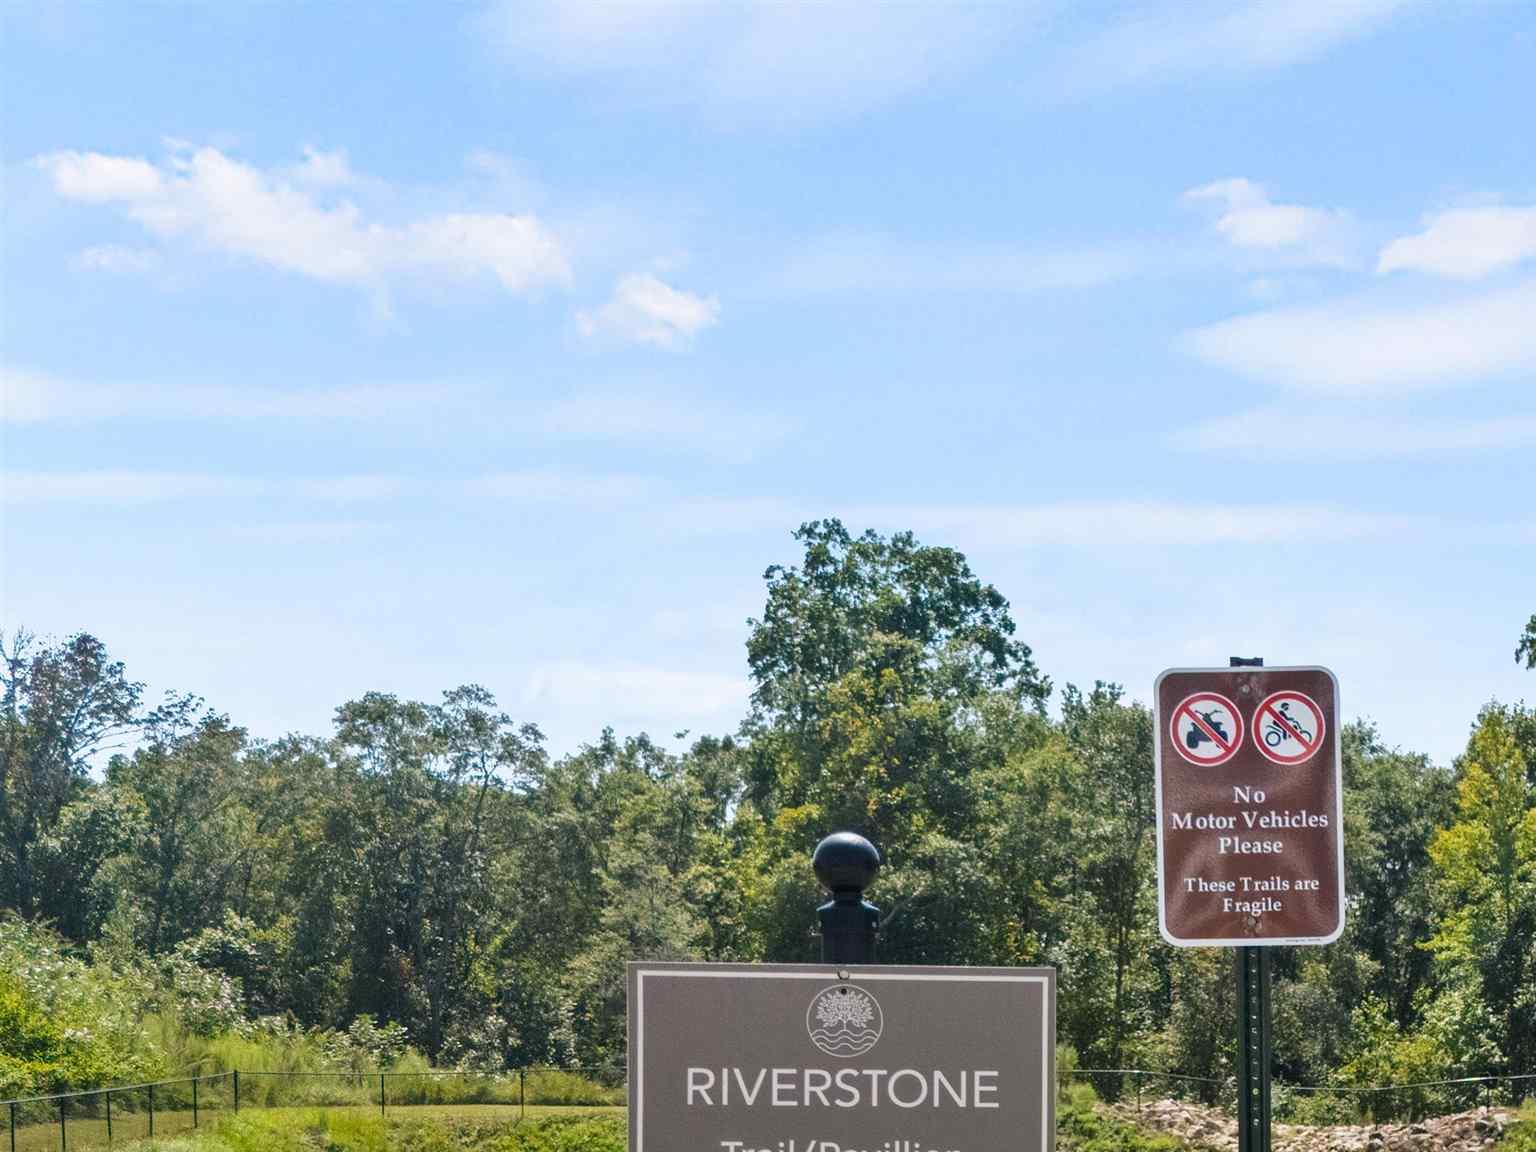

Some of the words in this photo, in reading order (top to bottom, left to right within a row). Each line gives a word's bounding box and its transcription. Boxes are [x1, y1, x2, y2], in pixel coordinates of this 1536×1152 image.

[1233, 786, 1266, 804] No
[1172, 812, 1236, 830] Motor
[1241, 809, 1329, 828] Vehicles
[1218, 836, 1283, 854] Please
[1184, 877, 1236, 892] These
[1240, 876, 1290, 892] Trails
[1294, 878, 1320, 891] are
[1222, 897, 1282, 916] Fragile
[686, 1067, 1000, 1109] RIVERSTONE
